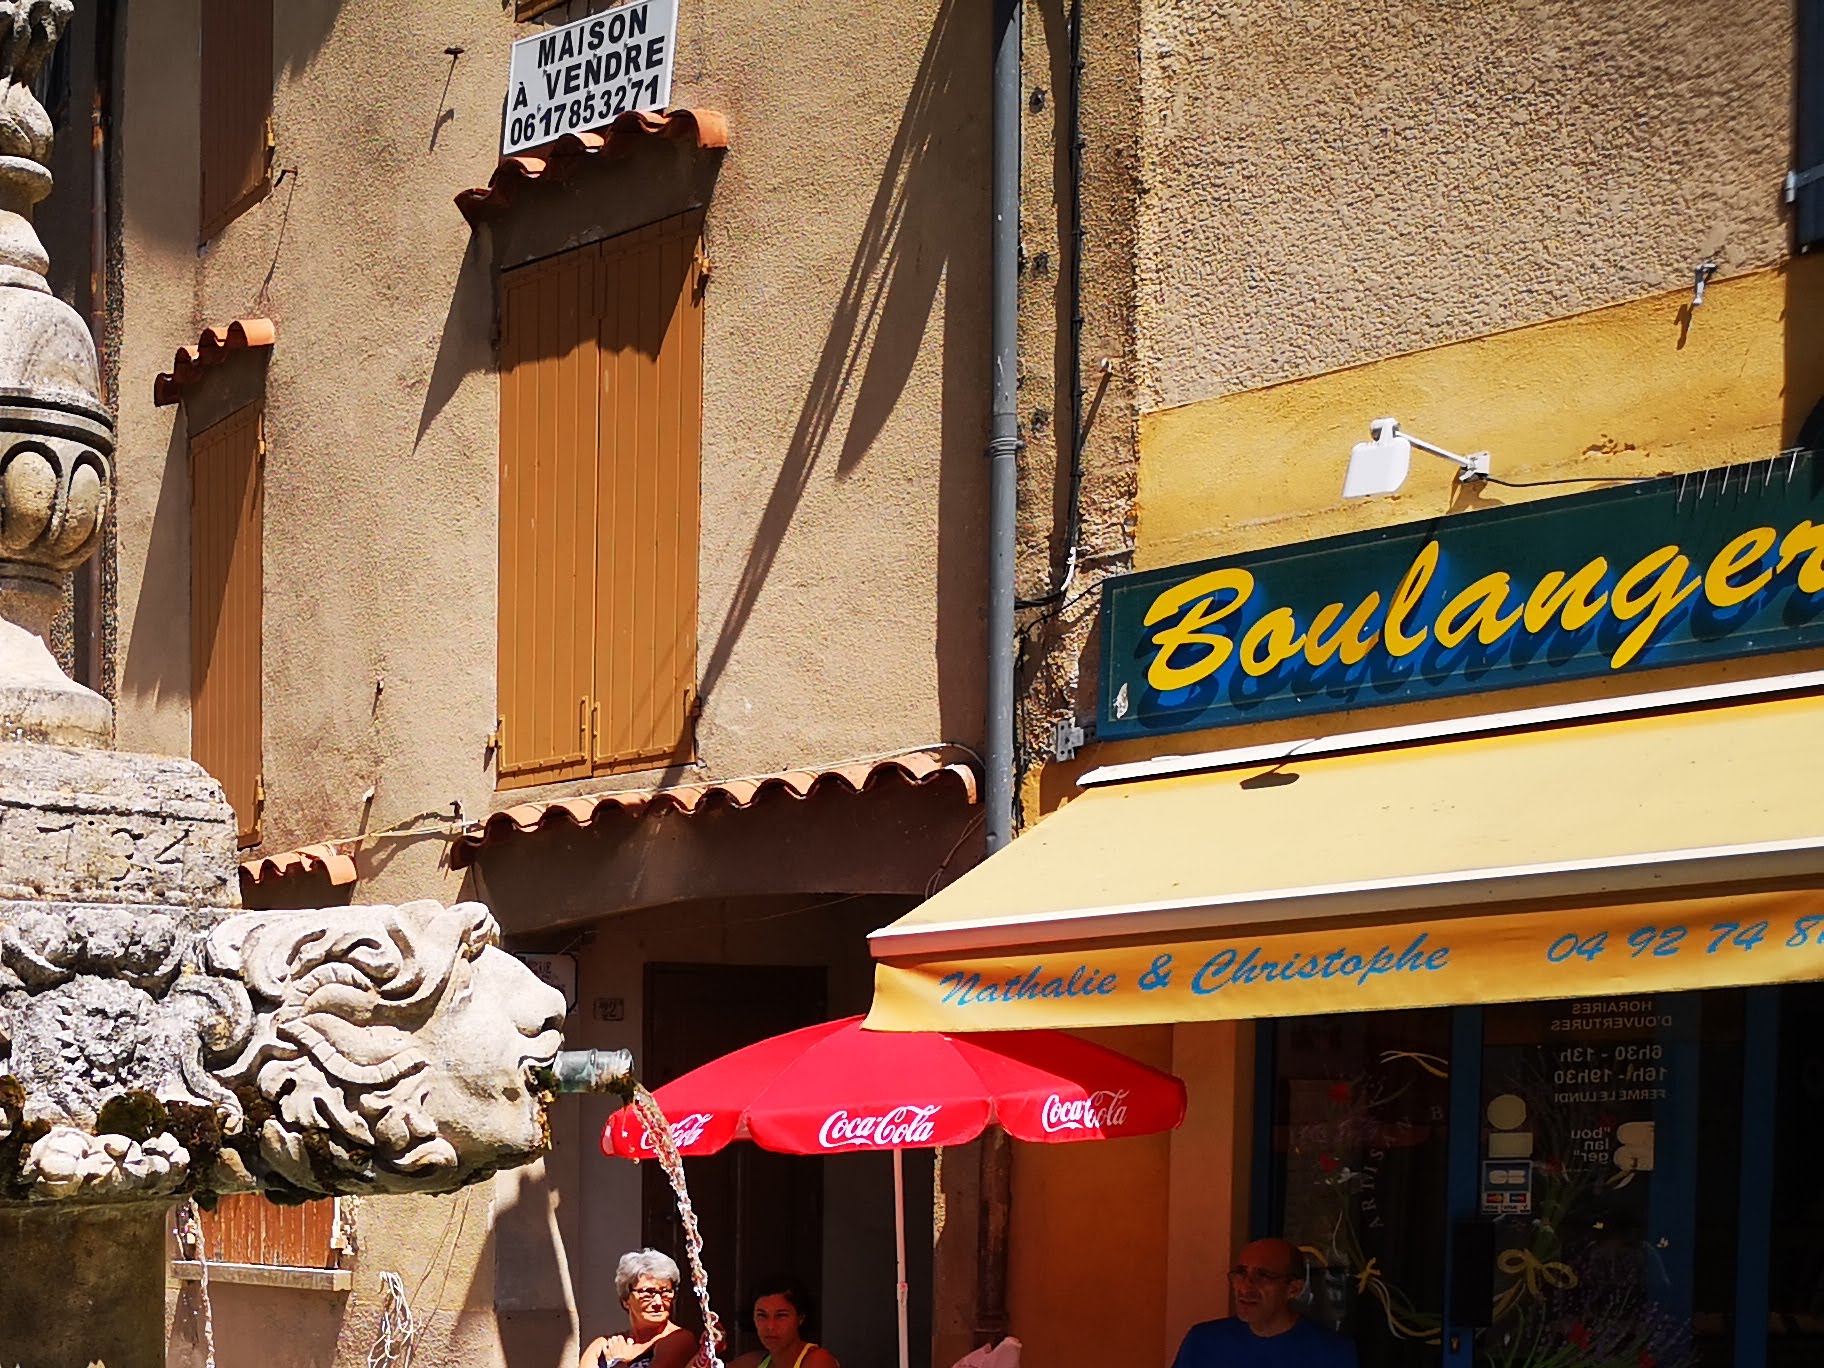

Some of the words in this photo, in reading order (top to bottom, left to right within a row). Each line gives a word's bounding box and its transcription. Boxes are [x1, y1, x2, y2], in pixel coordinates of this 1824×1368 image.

[537, 5, 648, 69] MAISON
[513, 81, 528, 112] À
[545, 36, 665, 101] VENDRE
[510, 75, 659, 146] 0617853271
[939, 965, 1118, 1006] Nathalie
[1138, 953, 1174, 991] &
[1190, 933, 1450, 996] Christophe
[1547, 931, 1609, 963] 04
[1627, 925, 1688, 958] 92
[1706, 920, 1769, 954] 74
[819, 1105, 942, 1148] Coca-Cola
[1042, 1089, 1130, 1132] Coca-Cola
